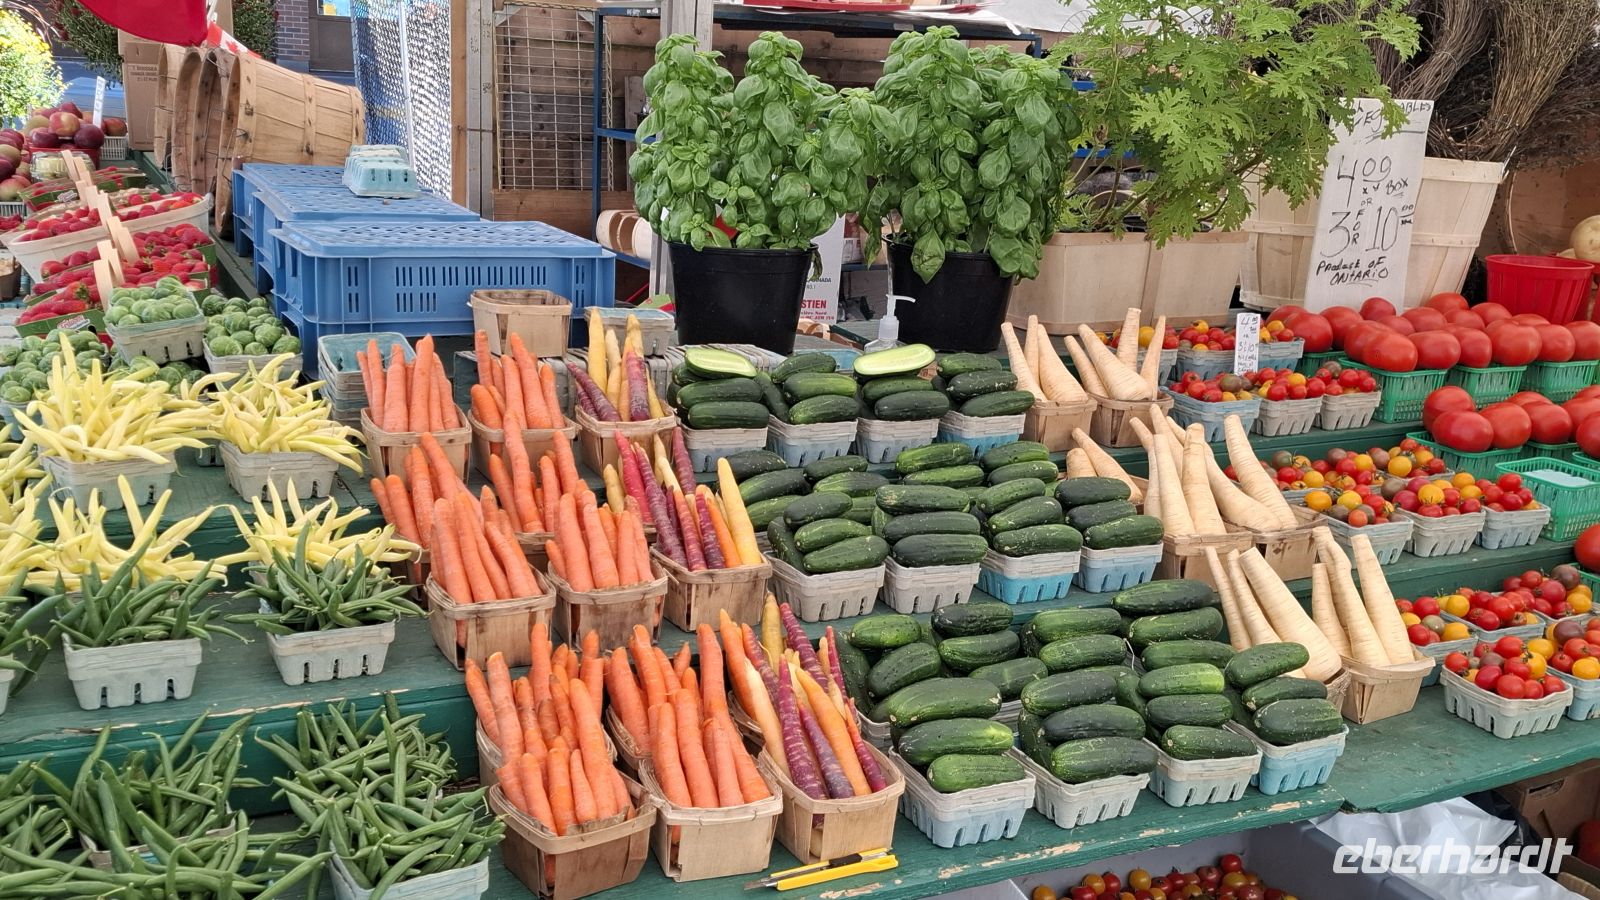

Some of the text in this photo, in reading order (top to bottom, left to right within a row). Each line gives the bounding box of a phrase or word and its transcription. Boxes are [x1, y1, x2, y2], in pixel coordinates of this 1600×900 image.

[1386, 177, 1409, 195] BOX
[1320, 211, 1351, 258] 3
[1365, 205, 1400, 252] 10
